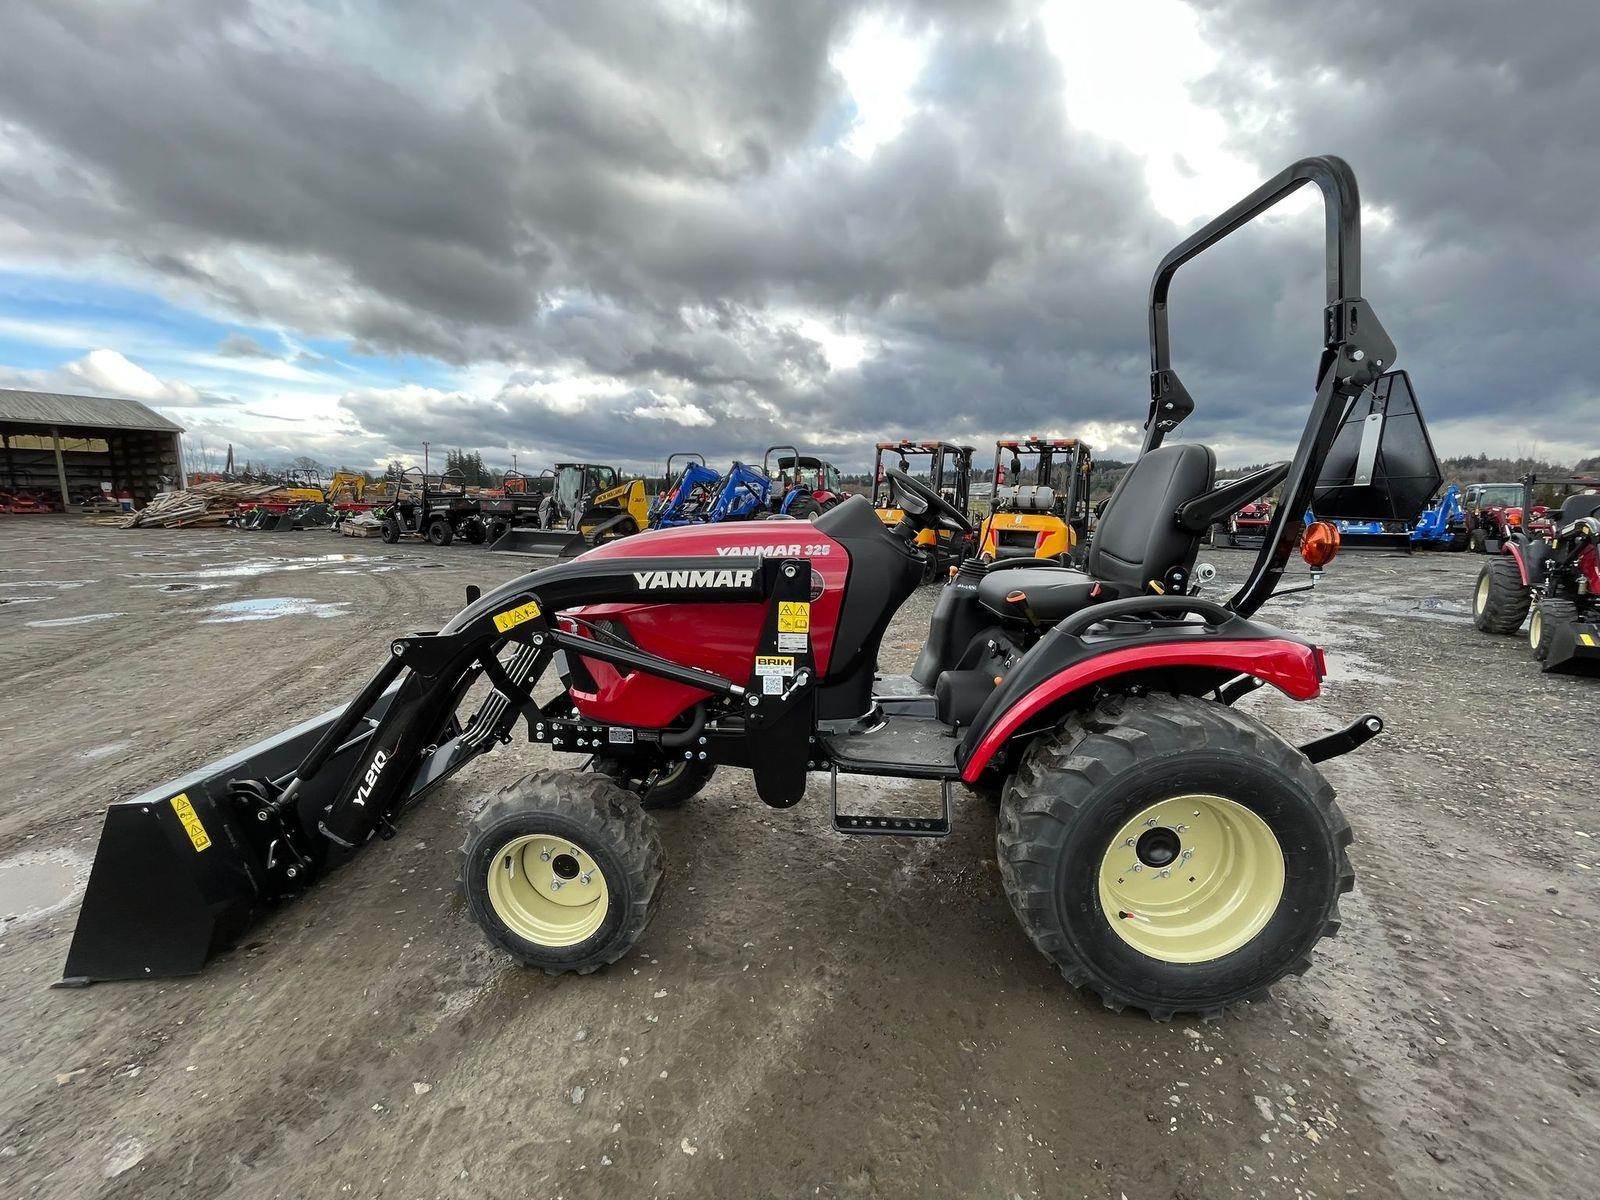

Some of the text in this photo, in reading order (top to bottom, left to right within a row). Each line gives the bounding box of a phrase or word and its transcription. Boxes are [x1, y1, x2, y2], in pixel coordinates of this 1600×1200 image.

[716, 544, 831, 557] YANMAR 325
[633, 570, 754, 590] YANMAR
[758, 658, 792, 666] BRIM
[353, 750, 388, 806] YL210
